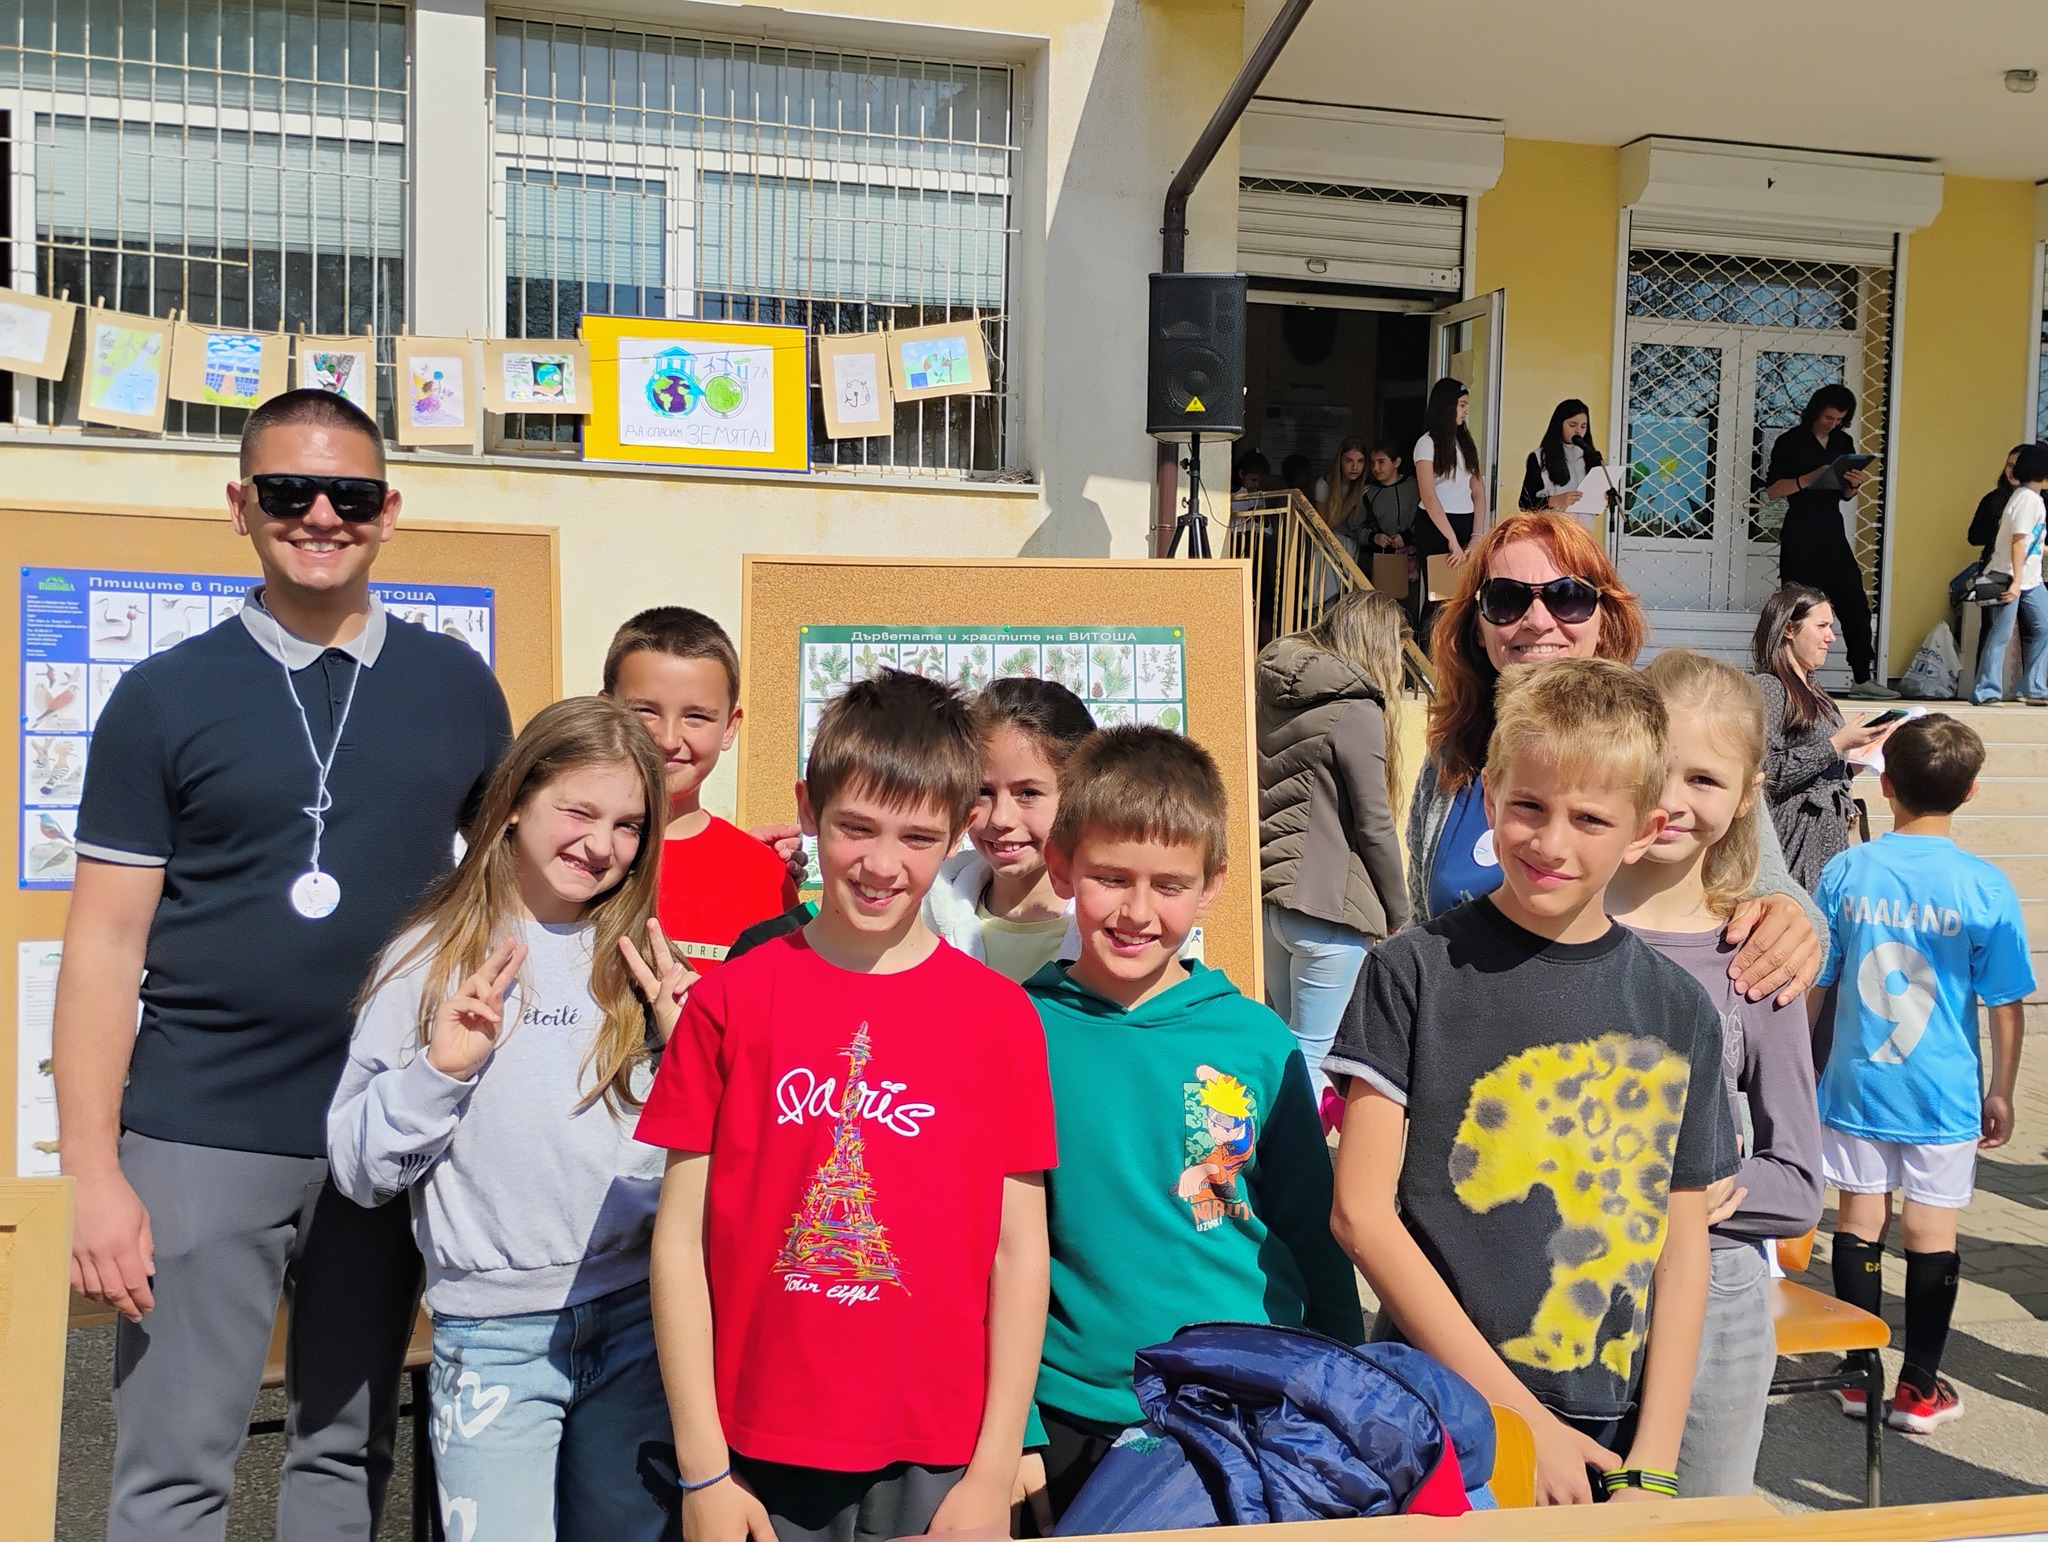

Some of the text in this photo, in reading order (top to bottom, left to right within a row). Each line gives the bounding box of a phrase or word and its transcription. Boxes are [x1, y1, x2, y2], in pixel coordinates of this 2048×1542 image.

[625, 424, 644, 437] ДА
[687, 424, 768, 447] ЗЕМЯТА!
[89, 576, 185, 591] Птиците
[209, 582, 249, 595] При
[851, 631, 1138, 642] Дърветата и храстите на ВИТОША
[1840, 895, 1962, 937] HAALAND
[676, 942, 719, 958] ORE
[1857, 941, 1937, 1065] 9
[523, 1005, 583, 1026] étoilé
[776, 1067, 936, 1137] Paris
[783, 1273, 821, 1293] Tour
